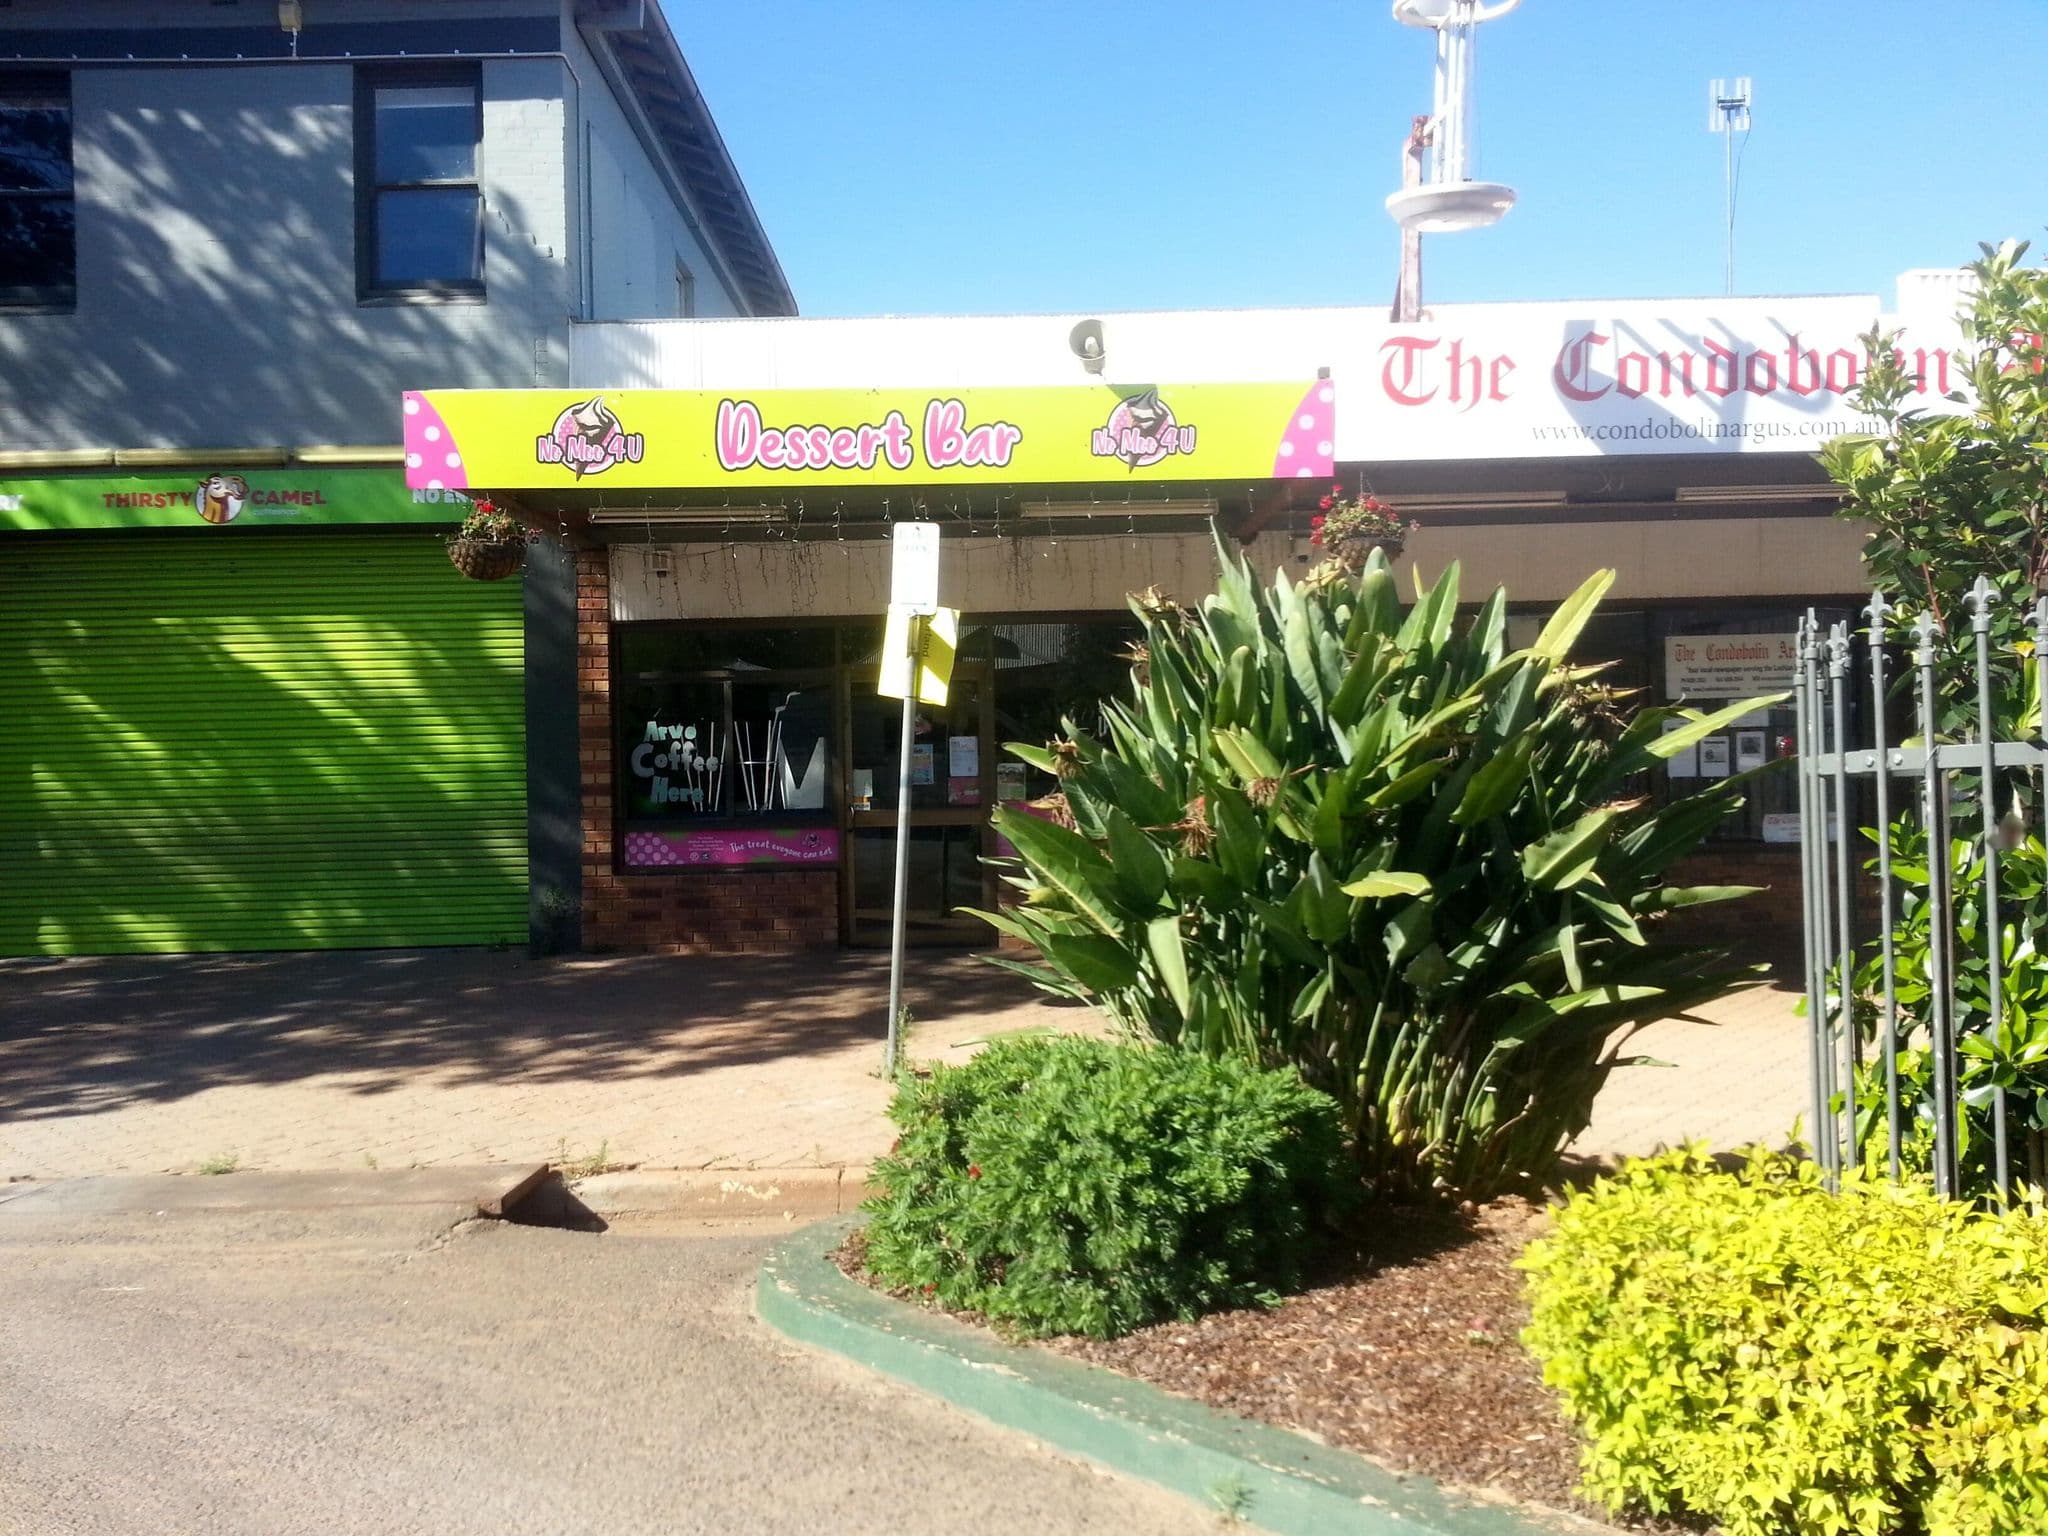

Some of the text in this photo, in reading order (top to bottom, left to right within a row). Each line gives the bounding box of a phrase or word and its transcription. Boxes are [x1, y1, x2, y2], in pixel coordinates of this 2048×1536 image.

[1379, 336, 1517, 414] The
[1554, 331, 1951, 402] Condobon
[715, 399, 1022, 471] Dessert Bar
[1092, 425, 1117, 456] No
[1121, 426, 1158, 456] Moo
[1532, 414, 1880, 445] www.condobolinargus.comau
[537, 433, 564, 464] No
[567, 434, 606, 463] Moo
[103, 490, 327, 509] THIRSTY CAMEL
[1674, 643, 1696, 662] The
[643, 721, 697, 742] Arvo
[631, 741, 719, 778] Coffee
[650, 776, 704, 803] Here
[730, 842, 745, 853] The
[747, 840, 770, 849] treat
[819, 846, 833, 857] eat
